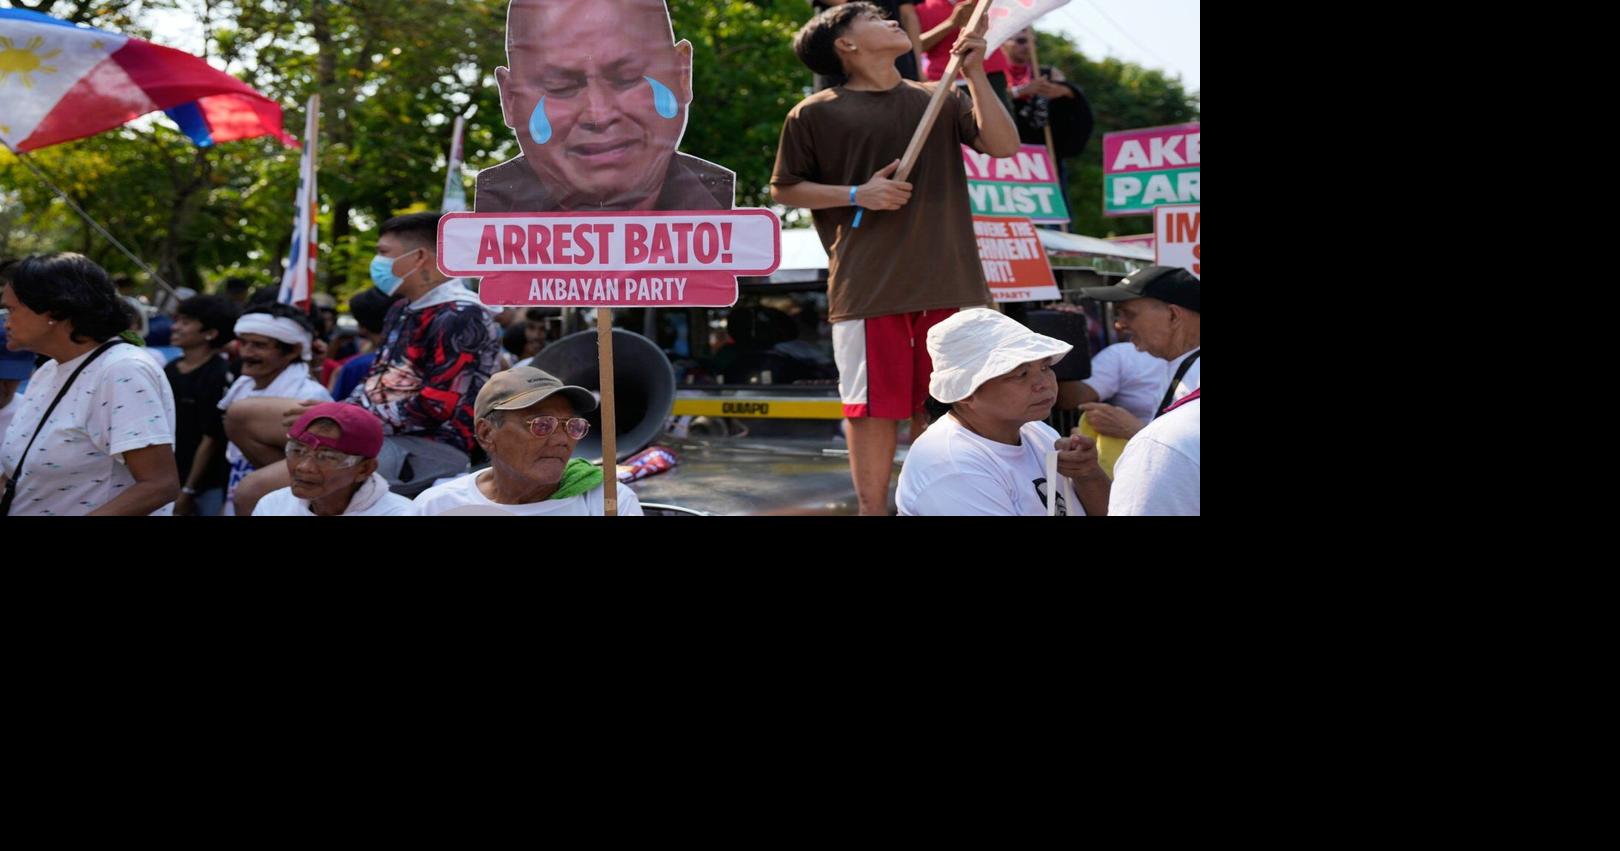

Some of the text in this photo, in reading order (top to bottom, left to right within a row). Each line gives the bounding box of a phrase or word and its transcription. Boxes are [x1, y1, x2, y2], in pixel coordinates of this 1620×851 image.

[1008, 222, 1036, 238] THE
[476, 222, 733, 265] ARREST BATO!
[528, 277, 688, 301] AKBAYAN PARTY
